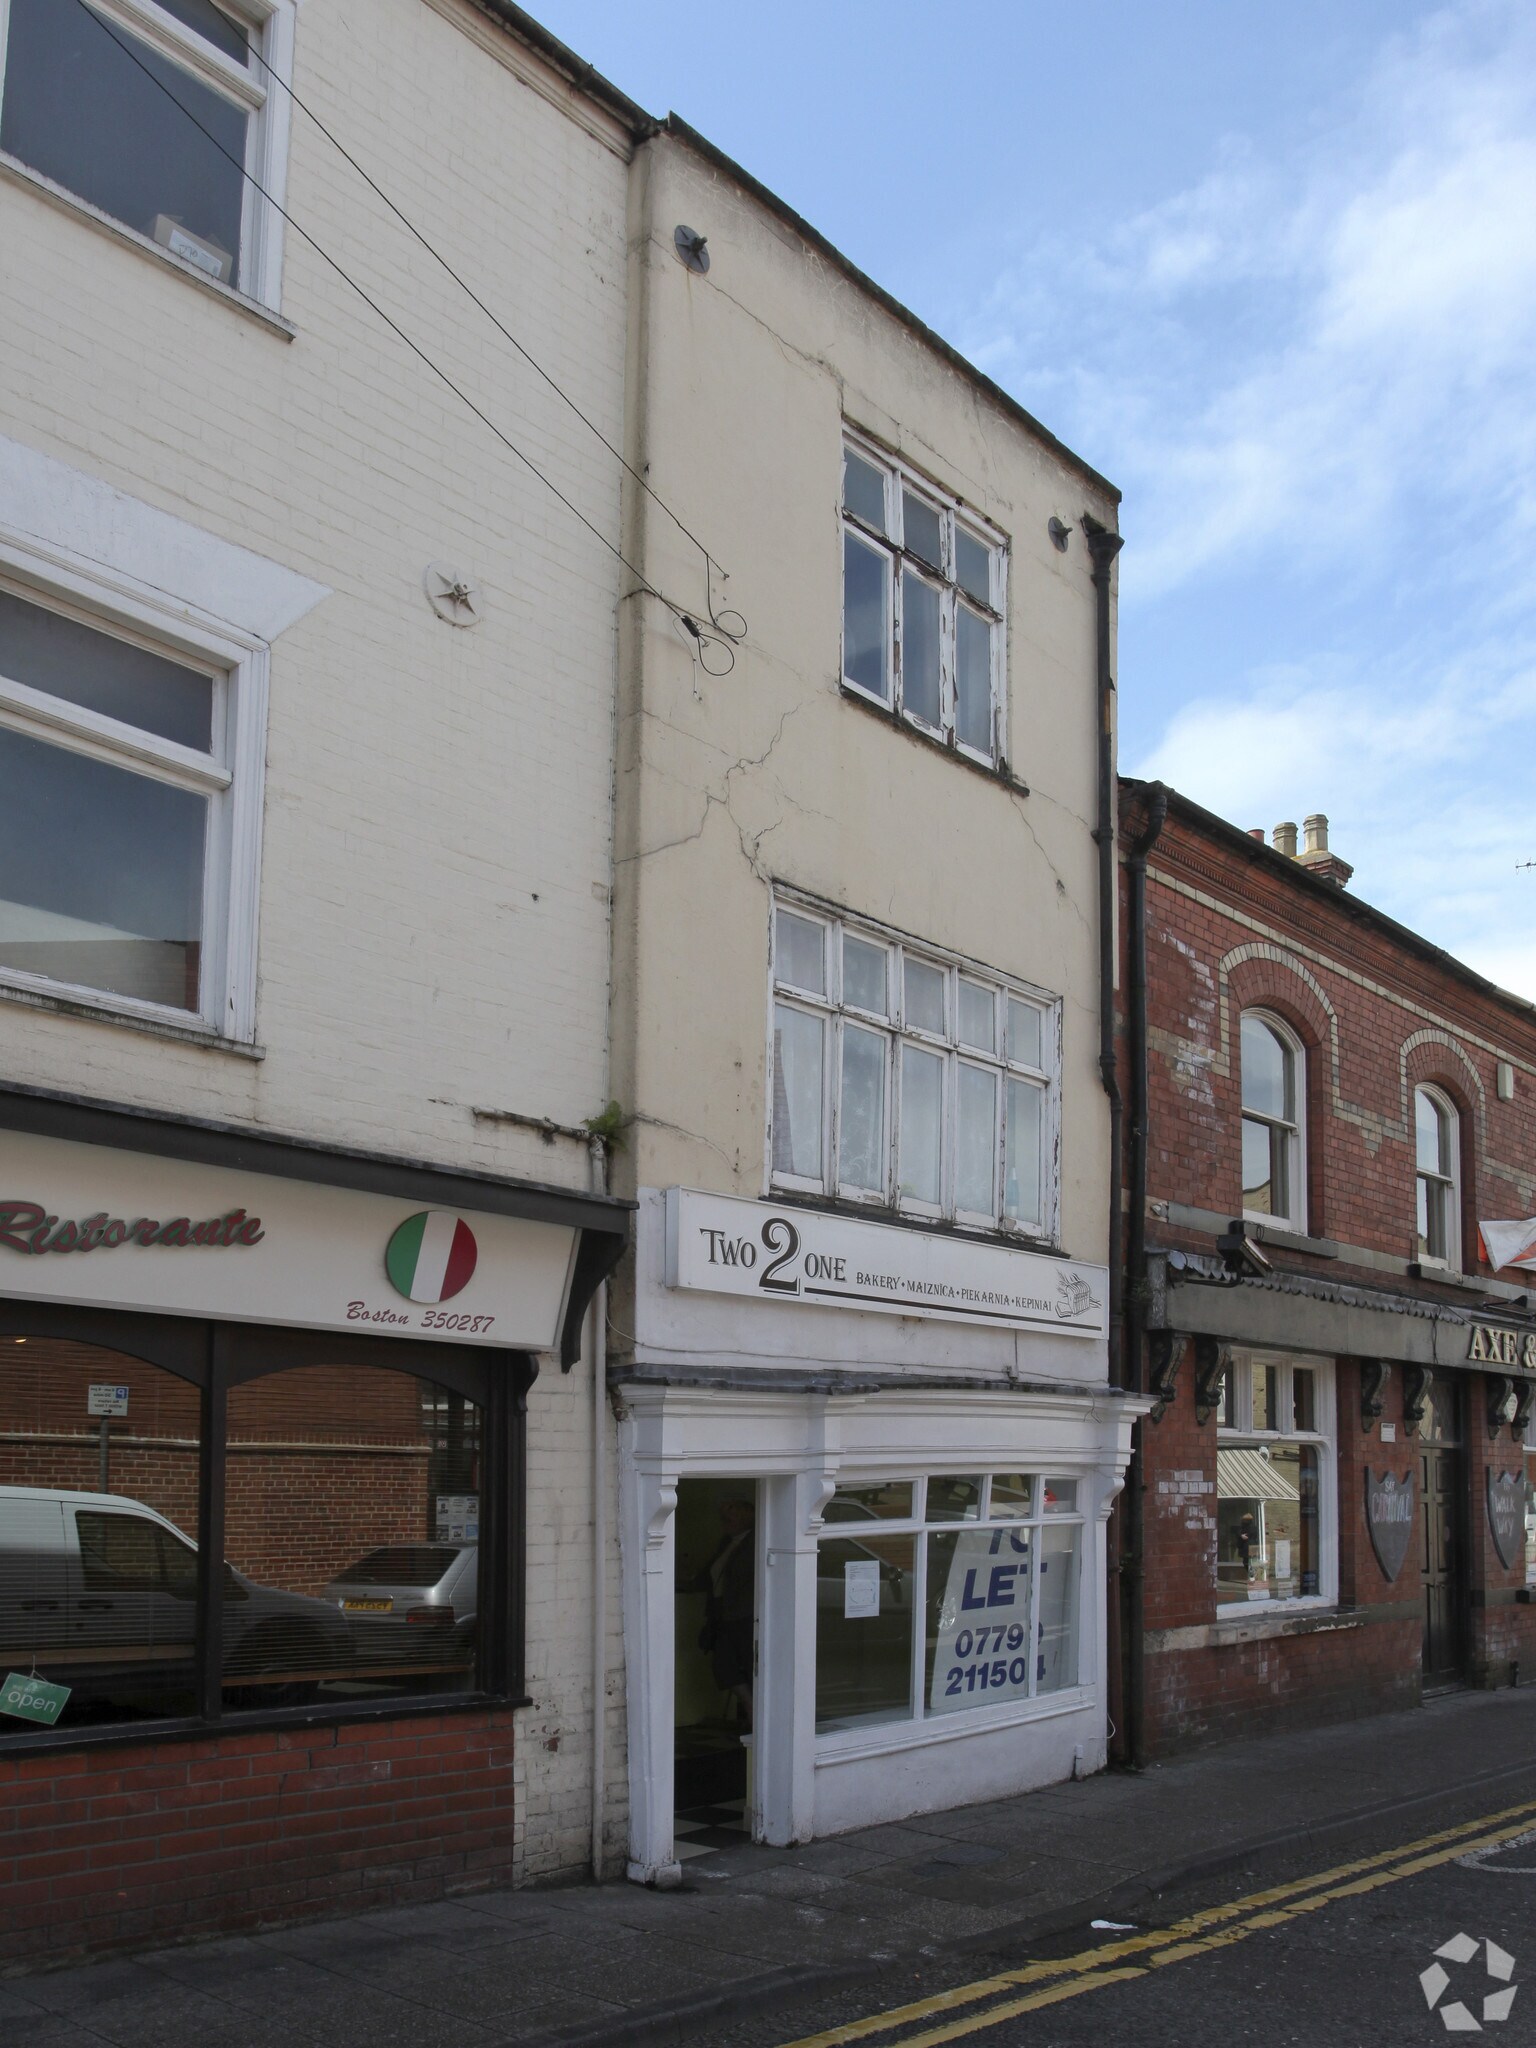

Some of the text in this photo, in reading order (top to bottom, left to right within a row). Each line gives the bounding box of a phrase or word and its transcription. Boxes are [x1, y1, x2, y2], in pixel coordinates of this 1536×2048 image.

[0, 1200, 265, 1255] Ristorante
[759, 1217, 801, 1296] 2
[856, 1271, 901, 1290] BAKERY
[961, 1287, 1011, 1307] PIEKARNIA
[346, 1301, 495, 1333] Boston 350287
[1468, 1325, 1536, 1369] AXE &
[8, 1691, 57, 1713] open
